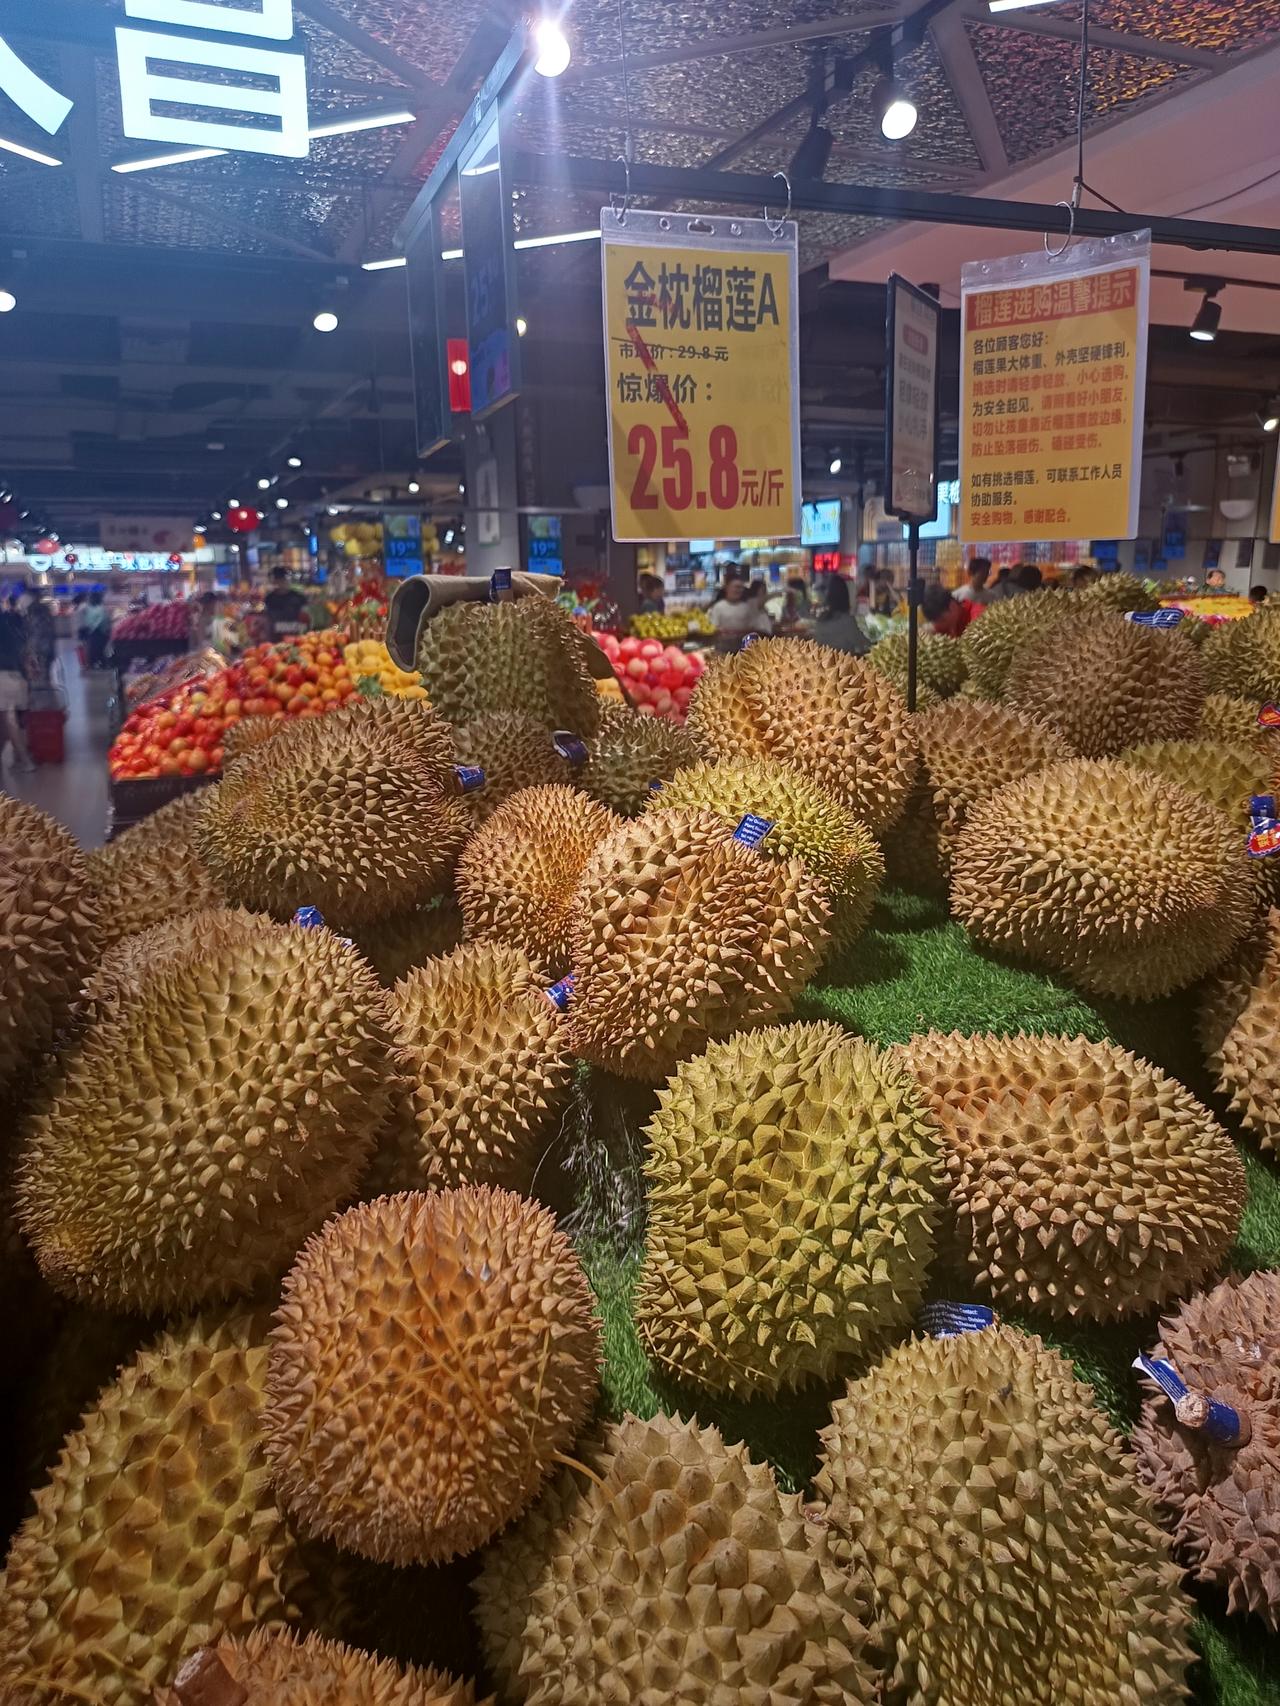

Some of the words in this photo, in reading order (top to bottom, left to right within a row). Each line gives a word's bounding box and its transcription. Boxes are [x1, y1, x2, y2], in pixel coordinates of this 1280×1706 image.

[624, 260, 780, 332] 金枕榴莲A
[974, 276, 1131, 327] 榴莲选购温馨提示
